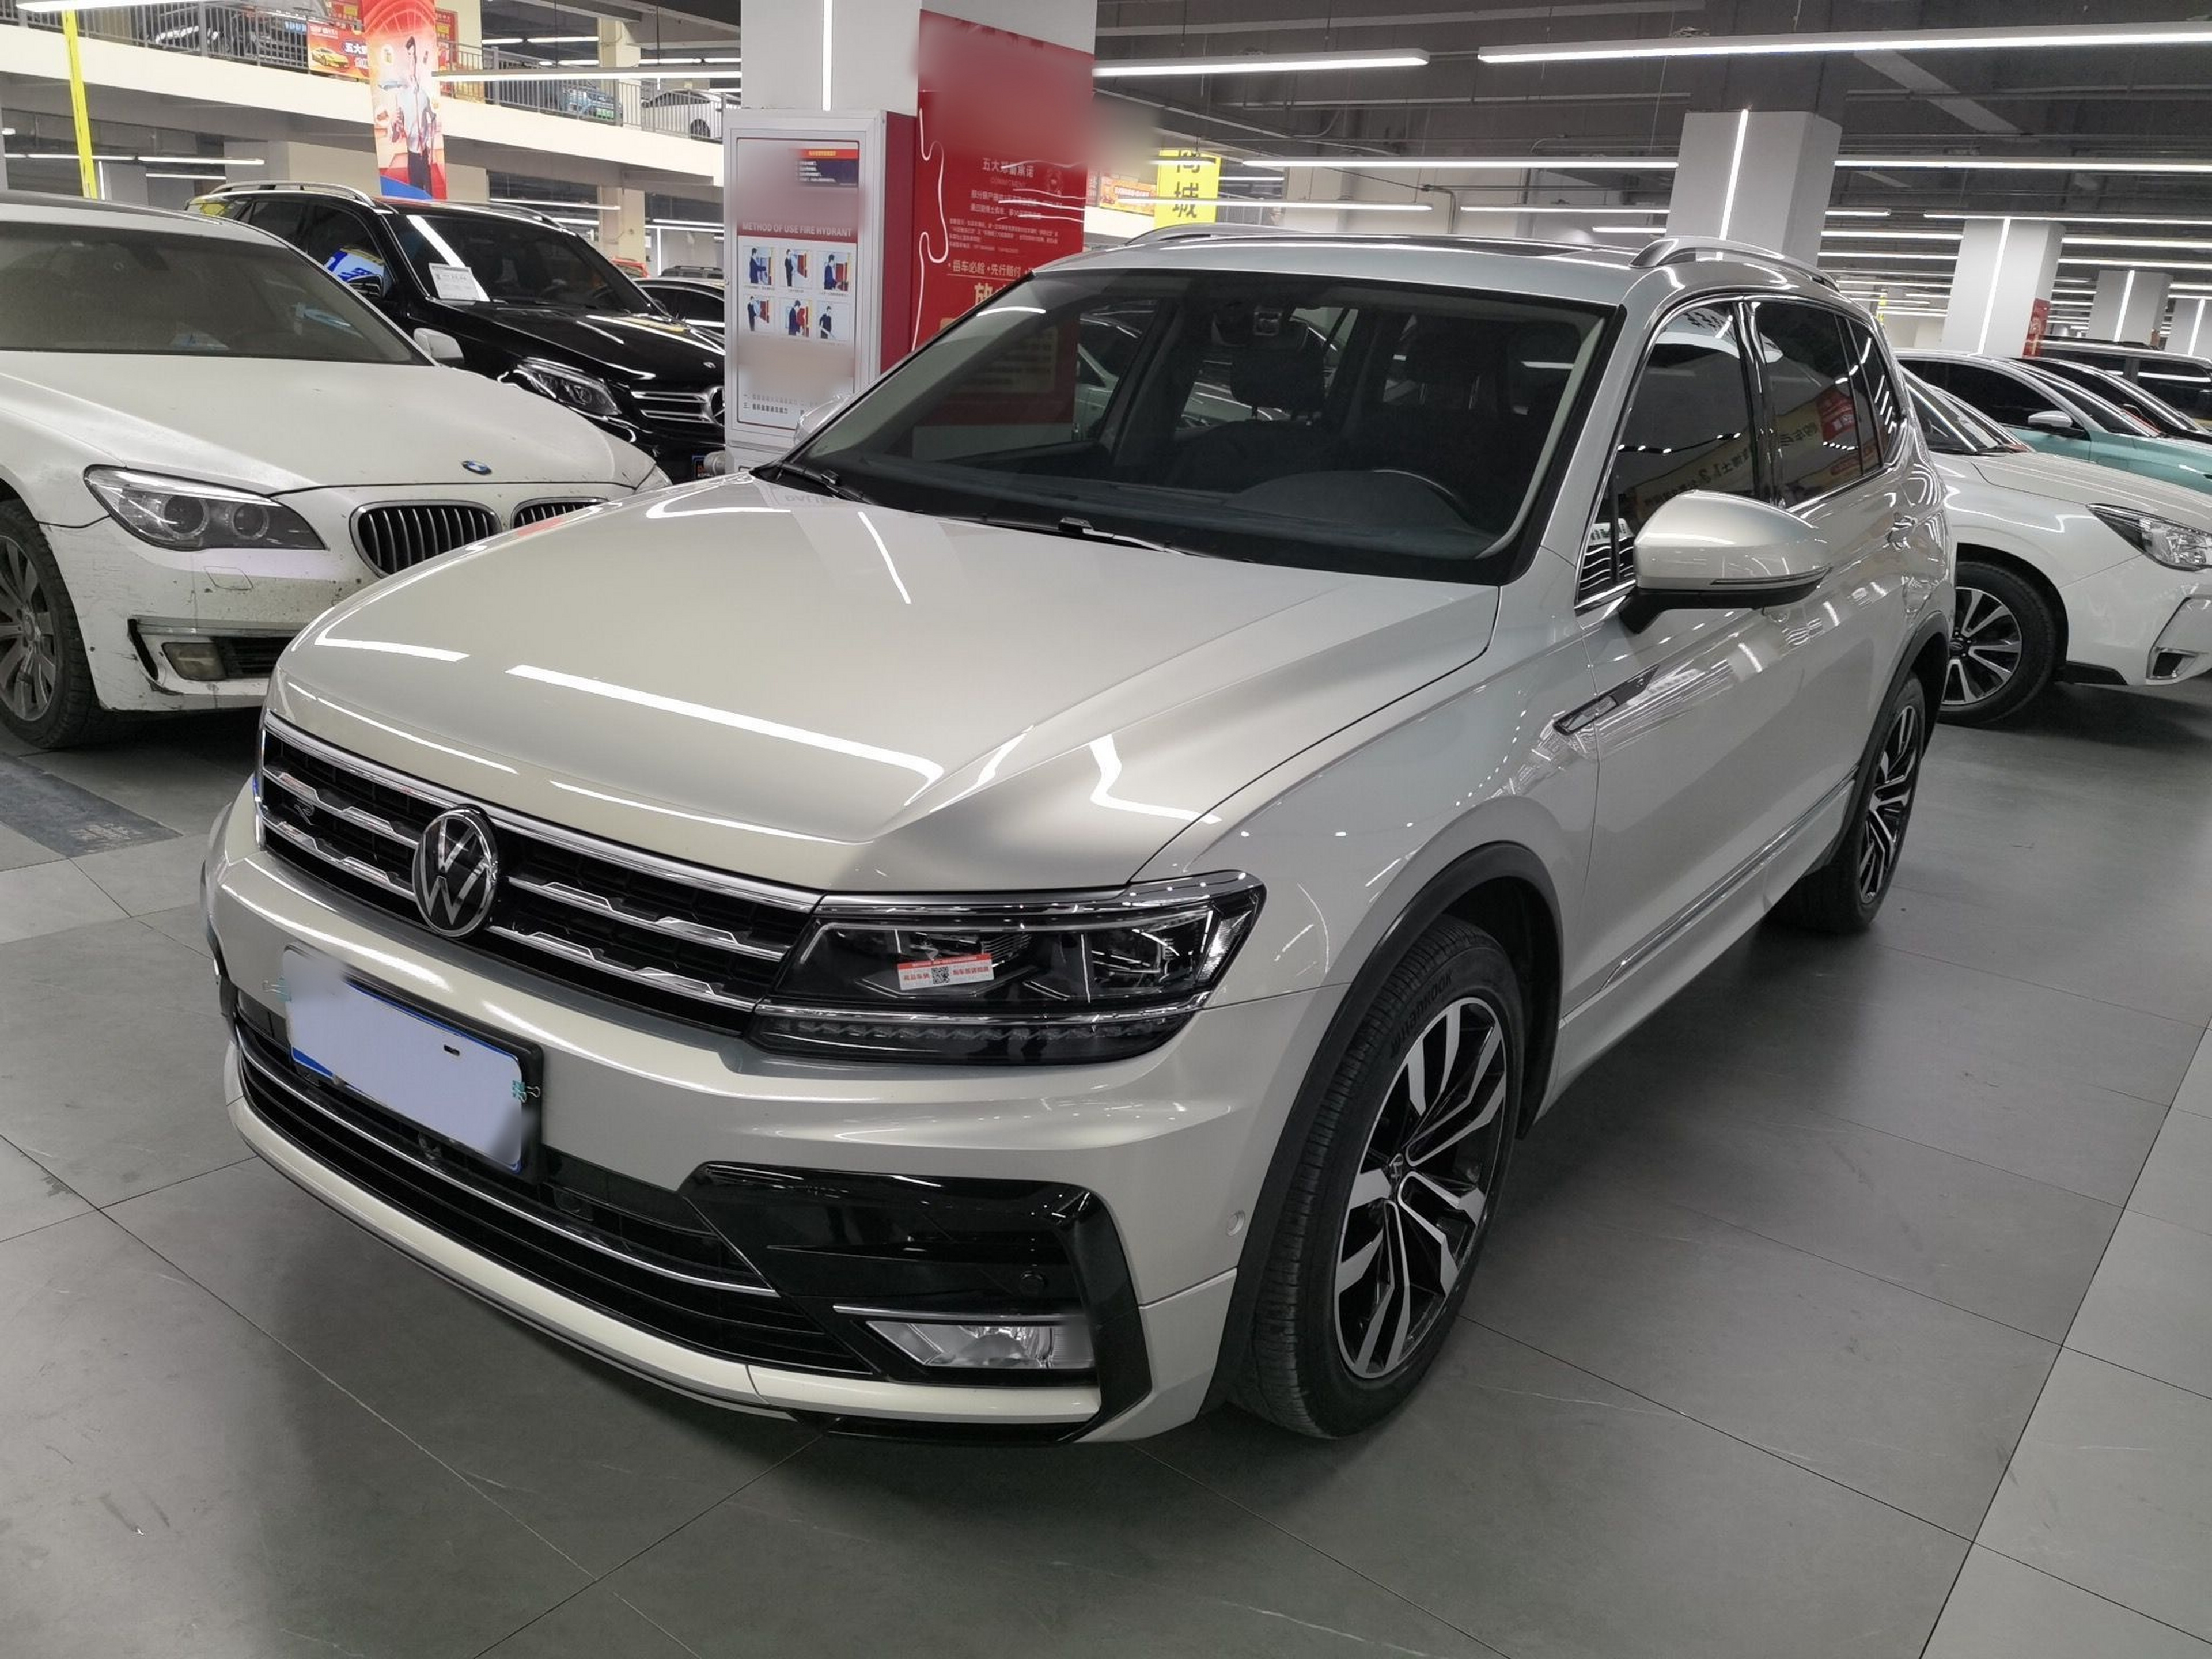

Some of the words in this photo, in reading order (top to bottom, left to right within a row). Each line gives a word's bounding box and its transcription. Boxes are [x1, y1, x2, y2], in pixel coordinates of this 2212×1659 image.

[742, 222, 772, 232] METHOD
[773, 224, 782, 232] OF
[785, 225, 798, 234] USE
[800, 226, 815, 235] FIRE
[816, 227, 852, 237] HYDRANT
